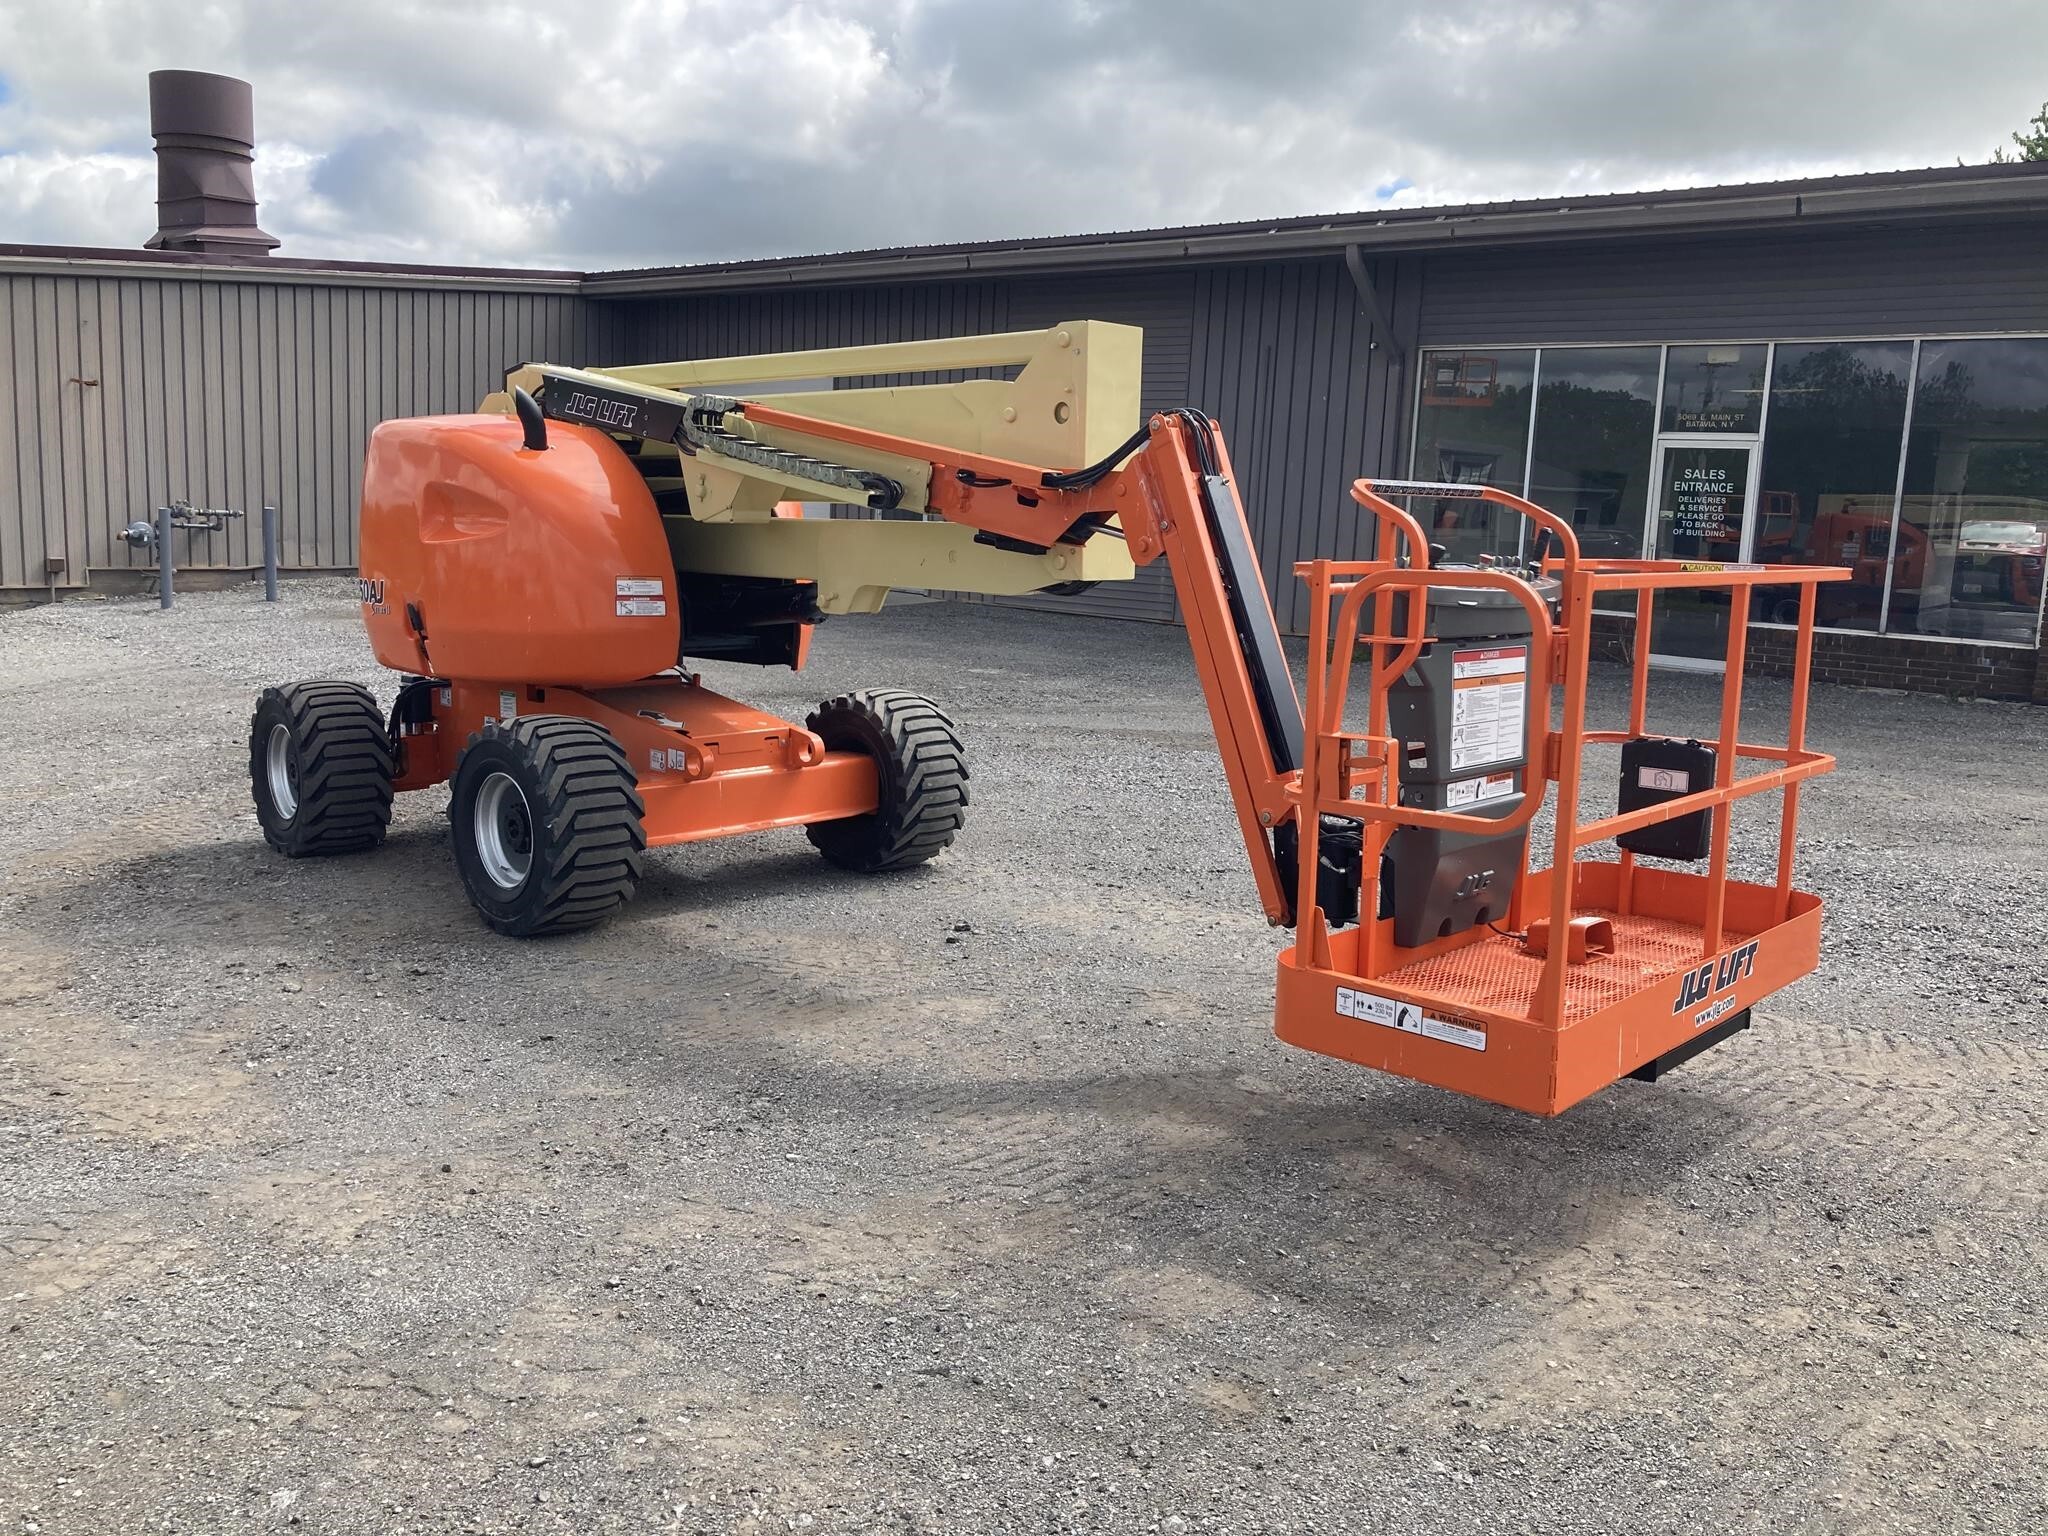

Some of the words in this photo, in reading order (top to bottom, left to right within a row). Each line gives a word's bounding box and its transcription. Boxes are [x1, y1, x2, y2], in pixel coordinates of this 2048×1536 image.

[565, 392, 597, 418] JLG
[597, 399, 638, 428] LIFT
[1711, 413, 1731, 421] MAIN
[1734, 413, 1745, 421] ST
[1684, 468, 1726, 480] SALES
[1674, 481, 1734, 493] ENTRANCE
[1678, 495, 1727, 505] DELIVERIES
[1688, 504, 1723, 513] SERVICE
[1677, 512, 1709, 520] PLEASE
[1712, 513, 1724, 521] GO
[1682, 520, 1692, 528] TO
[1695, 521, 1718, 529] BACK
[1673, 528, 1684, 536] OF
[1686, 529, 1726, 538] BUILDING
[1688, 564, 1721, 572] CAUTION
[1672, 960, 1715, 1016] JLG
[1714, 939, 1760, 994] LIFT
[1694, 994, 1736, 1028] www.jlg.com
[1439, 1013, 1481, 1031] WARNING
